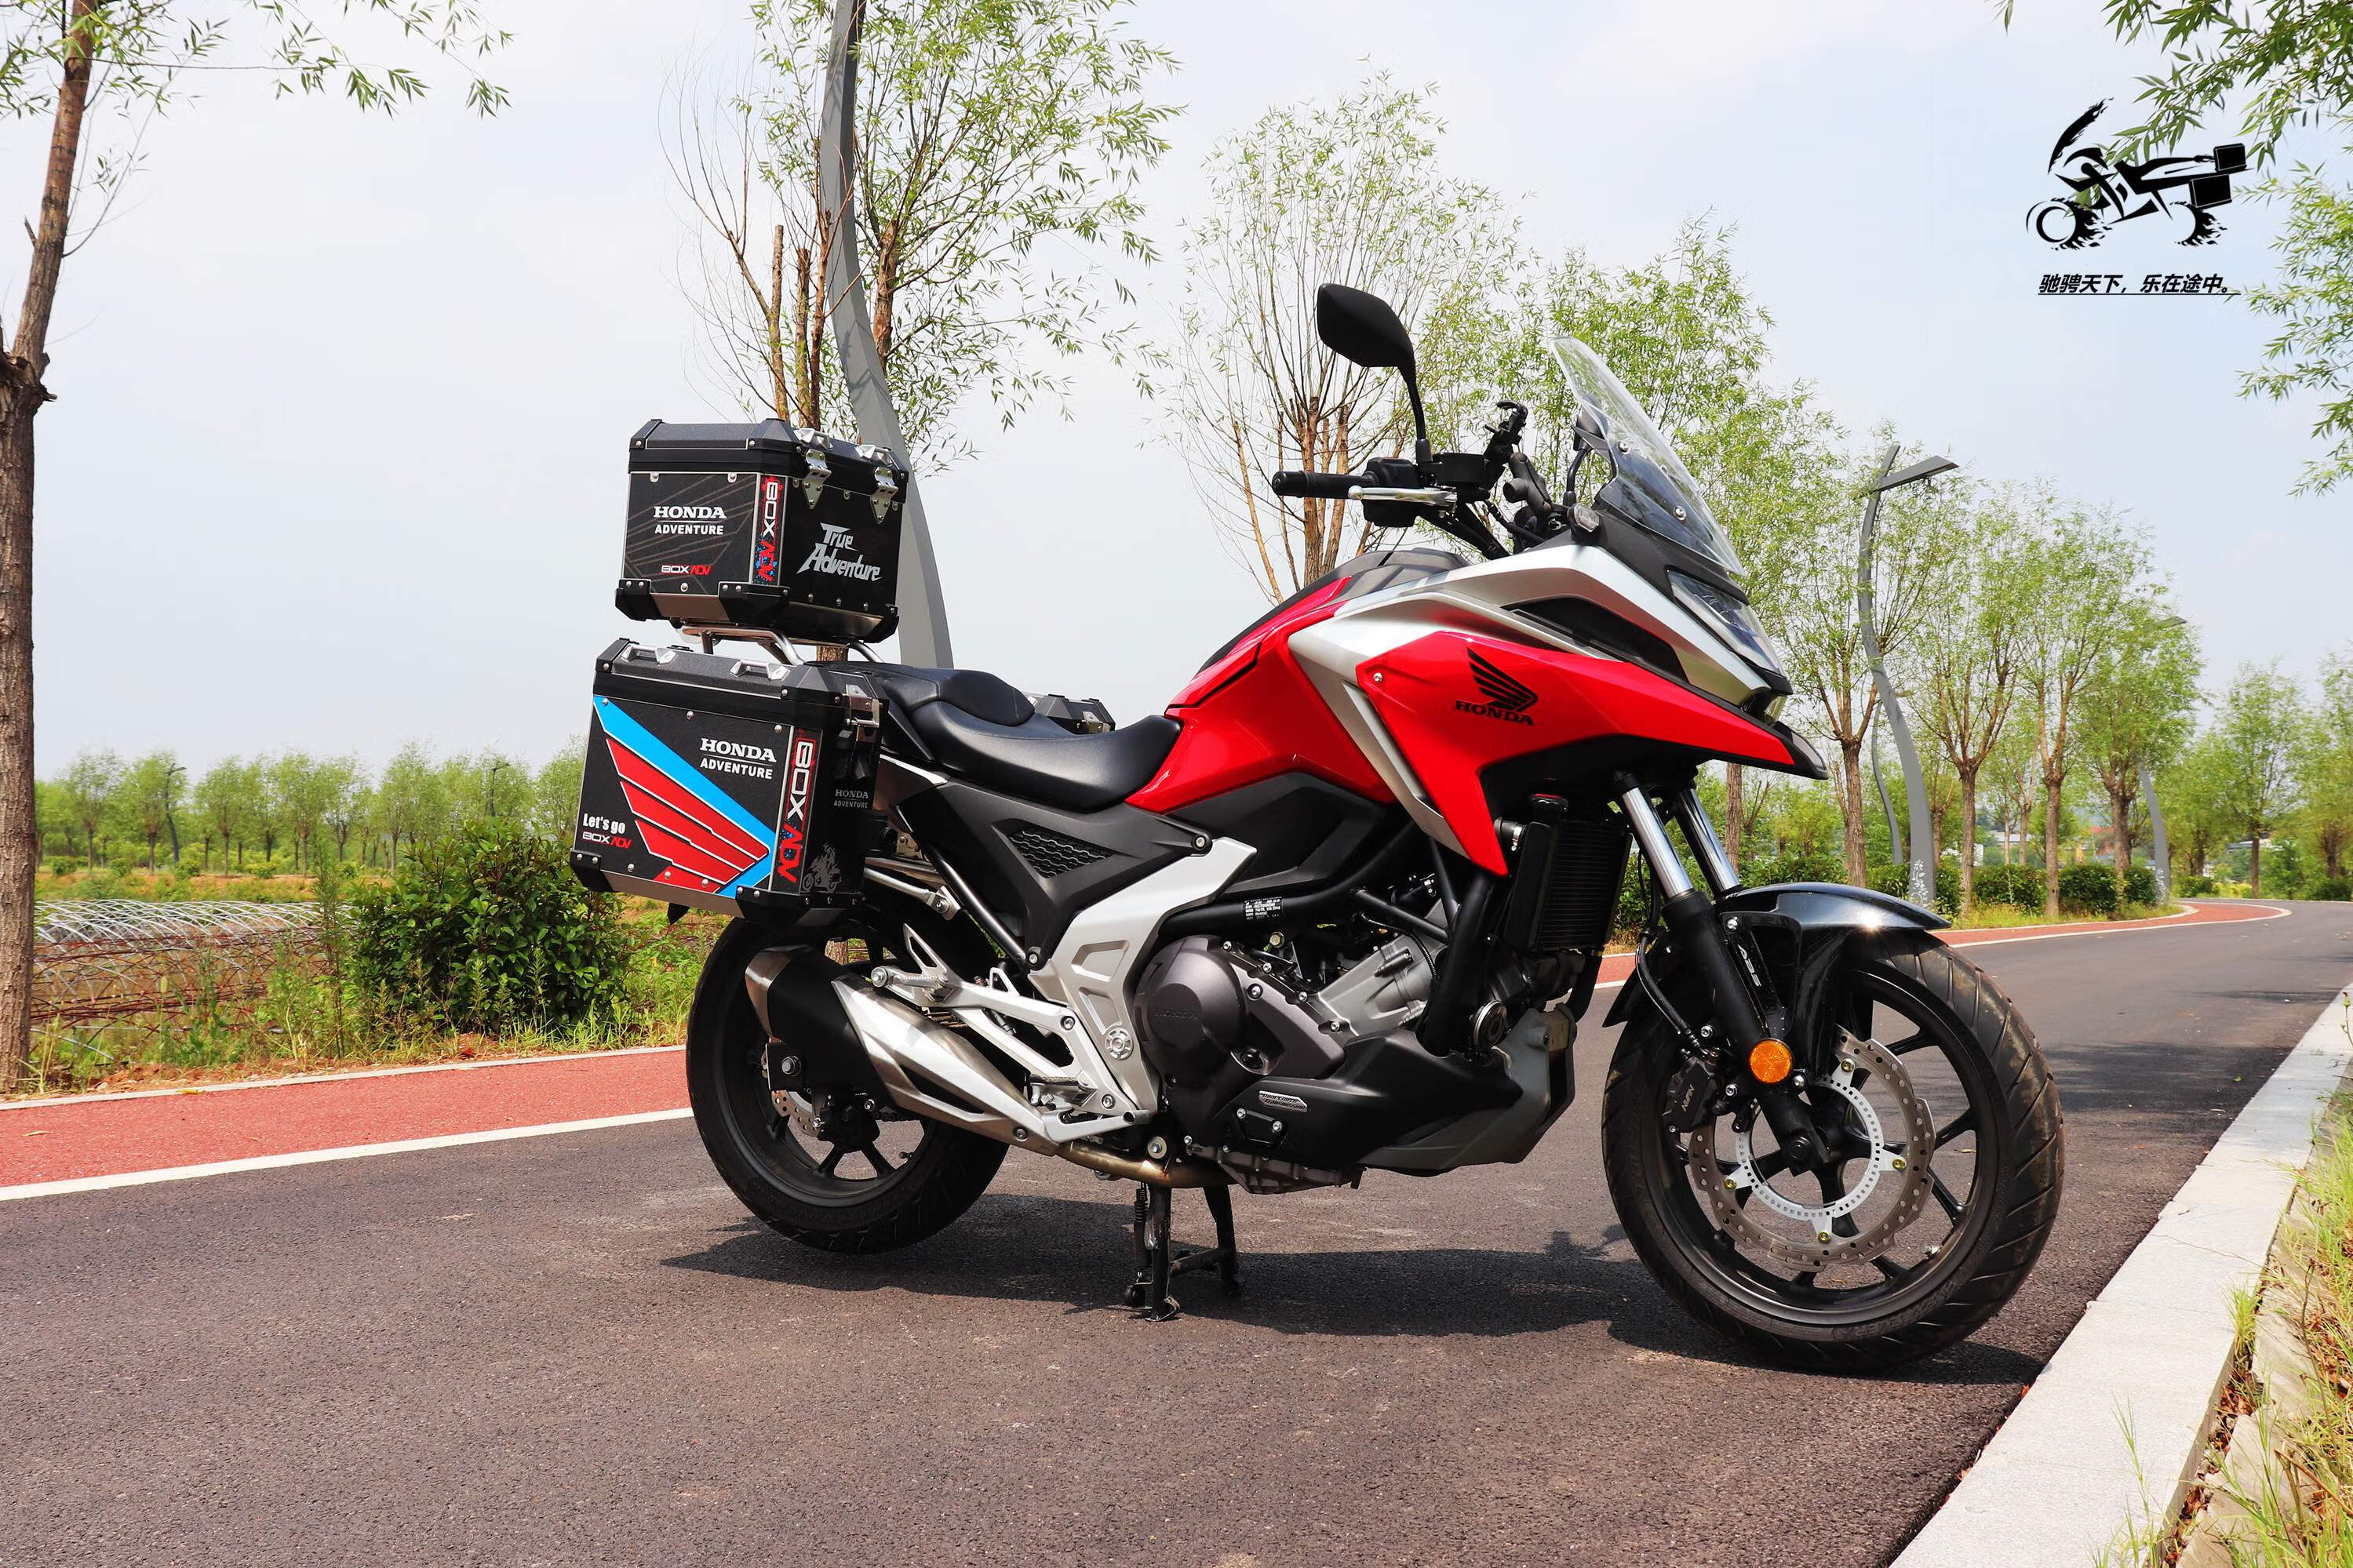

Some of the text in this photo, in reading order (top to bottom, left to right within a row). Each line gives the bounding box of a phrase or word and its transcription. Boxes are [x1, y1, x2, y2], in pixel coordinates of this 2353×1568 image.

[653, 505, 727, 519] HONDA
[654, 524, 725, 535] ADVENTURE
[820, 522, 861, 552] True
[796, 542, 883, 581] Adventure
[1455, 699, 1533, 726] HONDA
[699, 737, 778, 763] HONDA
[699, 758, 774, 780] ADVENTURE
[833, 800, 869, 809] ADVENTURE
[834, 789, 869, 799] HONDA
[582, 813, 626, 835] Let's go
[1737, 944, 1762, 987] ABS
